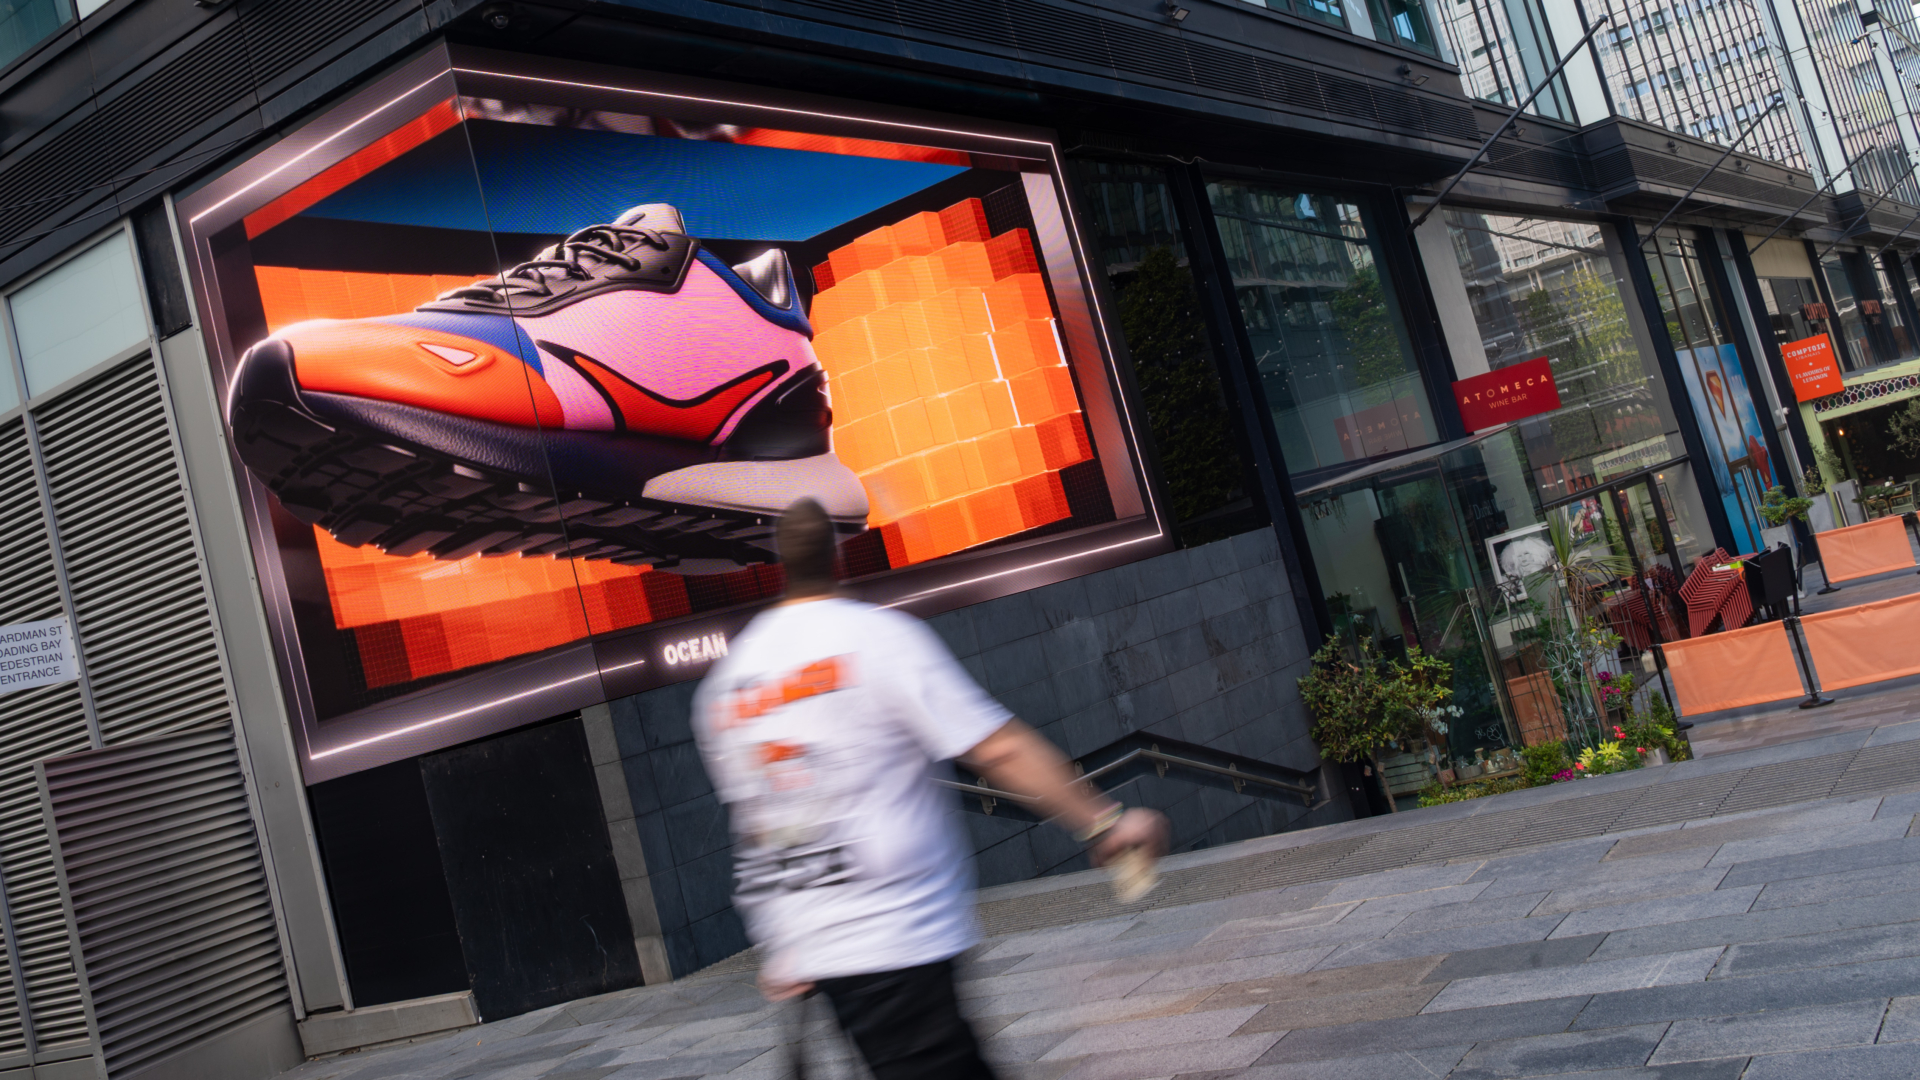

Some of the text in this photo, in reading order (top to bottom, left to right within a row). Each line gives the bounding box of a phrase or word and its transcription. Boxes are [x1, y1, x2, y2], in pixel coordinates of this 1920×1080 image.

[1787, 342, 1827, 358] COMPTOIR
[1795, 368, 1824, 379] FLAVOURS
[1802, 373, 1828, 384] LEBANON
[1463, 374, 1548, 405] ATOMECA
[1489, 393, 1528, 409] WINE BAR
[0, 625, 63, 644] ARDMAN ST
[41, 639, 61, 651] BAY
[664, 632, 729, 665] OCEAN
[0, 652, 63, 671] EDESTRIAN
[0, 666, 61, 685] ENTRANCE
